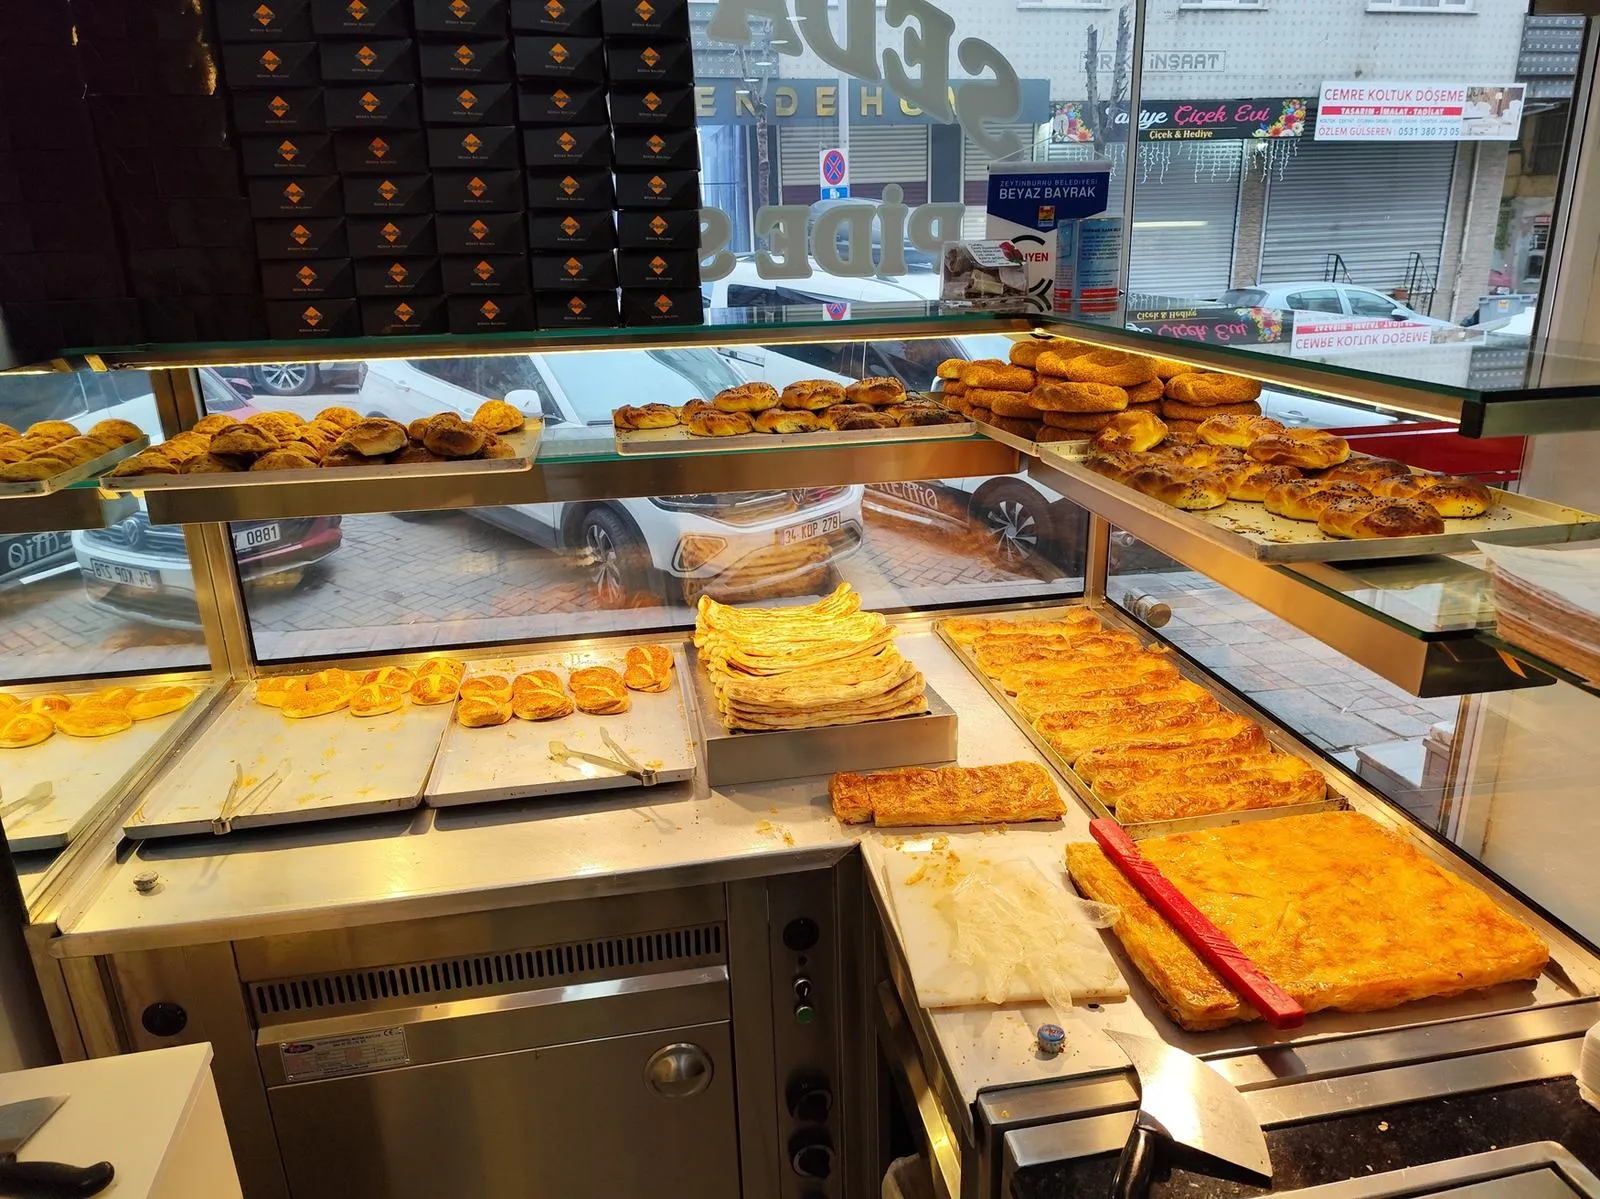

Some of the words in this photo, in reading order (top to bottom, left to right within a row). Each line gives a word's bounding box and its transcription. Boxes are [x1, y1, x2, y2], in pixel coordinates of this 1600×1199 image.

[1325, 88, 1364, 101] CEMRE
[1367, 89, 1412, 101] KOLTUK
[1174, 104, 1227, 127] Çiçek
[1234, 104, 1271, 122] Evi
[1149, 131, 1172, 139] Çiçek
[1183, 129, 1213, 139] Hediye
[1398, 127, 1418, 136] 0531
[1420, 127, 1436, 136] 380
[1438, 127, 1449, 136] 73
[1450, 127, 1460, 136] 05
[1000, 187, 1041, 199] BEYAZ
[1045, 186, 1096, 199] BAYRAK
[246, 525, 277, 545] 0881
[785, 529, 796, 544] 34
[822, 515, 838, 532] 278
